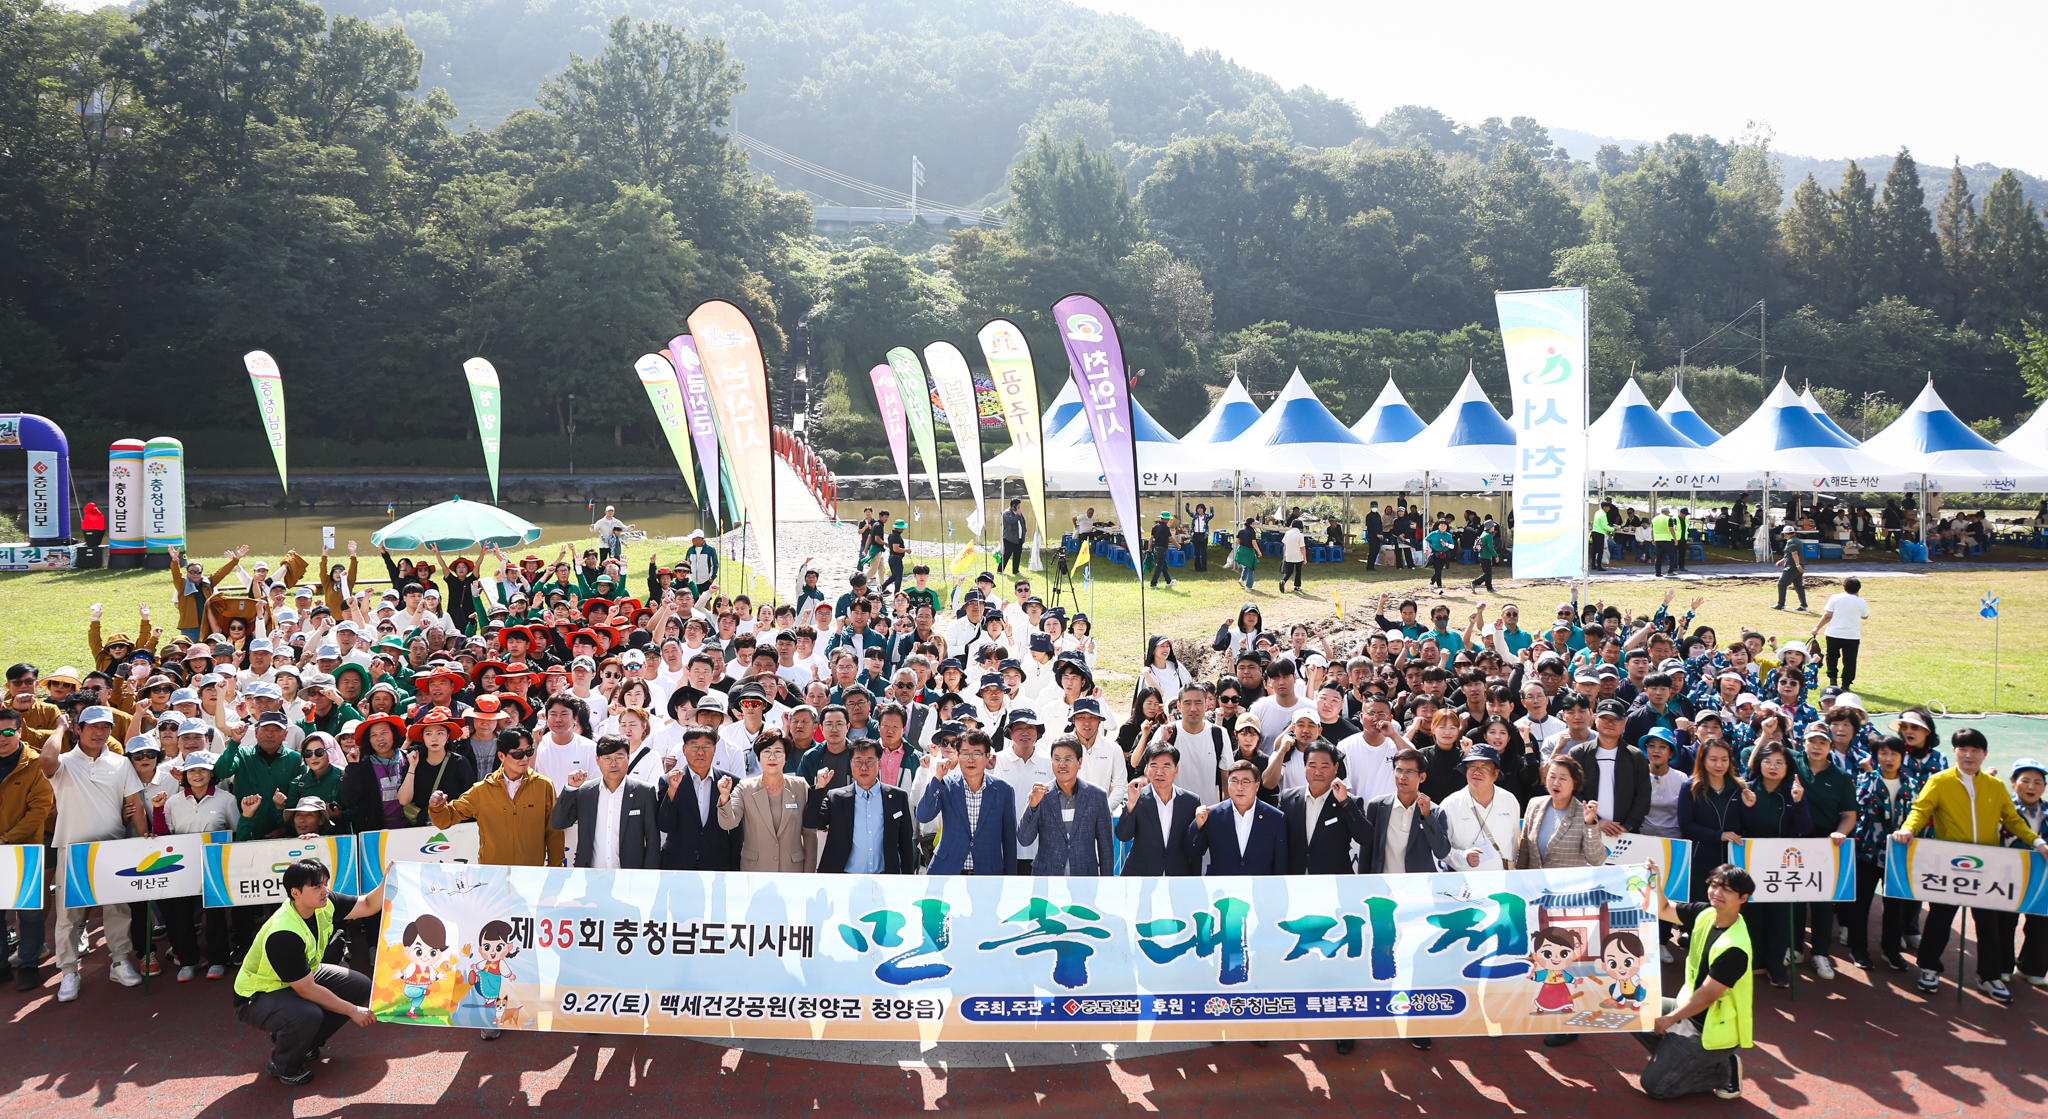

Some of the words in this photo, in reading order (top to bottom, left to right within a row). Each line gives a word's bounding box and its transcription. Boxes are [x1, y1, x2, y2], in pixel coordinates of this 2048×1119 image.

[1143, 472, 1177, 486] 안시
[1320, 473, 1372, 489] 공주시
[1675, 474, 1720, 488] 아산시
[1831, 475, 1857, 487] 해뜨는
[1860, 475, 1880, 487] 서산
[33, 476, 48, 527] 중도일보
[115, 482, 128, 533] 충청남도
[151, 478, 165, 534] 충청남도
[130, 877, 170, 891] 예산군
[240, 878, 283, 897] 태안
[1763, 870, 1823, 893] 공주시
[1920, 873, 2014, 900] 천안시
[508, 916, 604, 952] 제35회
[612, 918, 815, 959] 충청남도지사배
[562, 993, 650, 1014] 9.27(토)
[660, 995, 862, 1020] 백세건강공원(청양군
[871, 998, 945, 1020] 청양읍)
[973, 1000, 1043, 1017] 주최,주관
[1081, 999, 1141, 1015] 중도일보
[1152, 999, 1183, 1014] 후원
[1230, 997, 1297, 1016] 충청남도
[1306, 995, 1368, 1013] 특별후원
[1411, 993, 1455, 1011] 청양군
